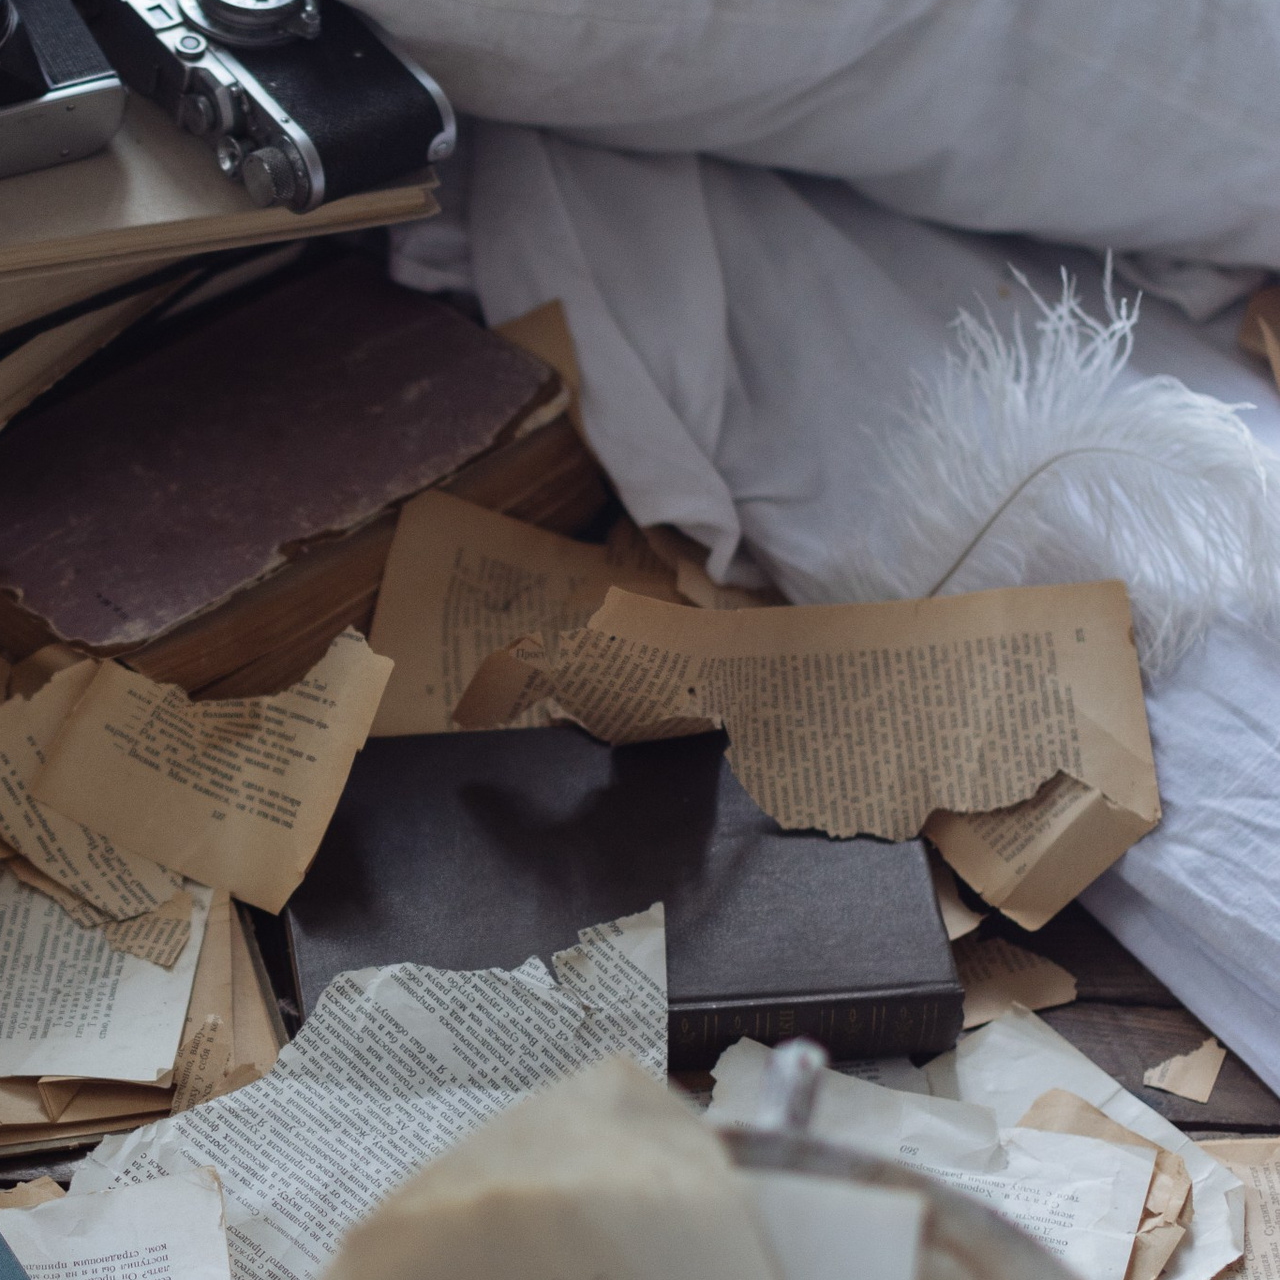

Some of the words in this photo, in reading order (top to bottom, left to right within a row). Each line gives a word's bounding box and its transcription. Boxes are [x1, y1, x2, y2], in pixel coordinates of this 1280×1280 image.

[398, 964, 424, 988] собой
[561, 958, 587, 983] своих
[343, 976, 365, 997] взял
[389, 972, 436, 1014] откровение.
[595, 973, 632, 1009] слушать.
[422, 985, 450, 1011] самим
[448, 1007, 466, 1026] над
[596, 991, 638, 1031] анекдотов
[630, 1007, 655, 1030] легче
[407, 1035, 427, 1054] был
[438, 1014, 490, 1064] заключалось
[465, 1024, 510, 1067] господства
[197, 1047, 211, 1071] себя
[274, 1057, 288, 1070] на
[425, 1051, 438, 1064] не
[286, 1067, 326, 1101] несмотря
[299, 1061, 334, 1095] научила.
[499, 1073, 521, 1093] этом
[508, 1065, 533, 1090] терял
[333, 1093, 350, 1109] вас
[456, 1081, 483, 1105] видел
[215, 1110, 263, 1151] романтики.
[348, 1107, 387, 1139] кой-чему
[189, 1136, 206, 1151] это
[386, 1137, 408, 1158] тоже
[898, 1143, 920, 1156] 560
[203, 1147, 229, 1169] менее
[259, 1148, 290, 1173] против
[892, 1157, 963, 1179] разговорами.
[238, 1175, 255, 1190] тем
[287, 1170, 338, 1212] возражений
[950, 1181, 993, 1197] Хорошо
[967, 1175, 1006, 1189] своими
[1009, 1181, 1041, 1195] толку
[270, 1196, 310, 1232] нравится,
[225, 1223, 266, 1258] Придется
[308, 1229, 321, 1242] не
[72, 1249, 139, 1267] страдающим
[320, 1240, 337, 1254] это
[140, 1263, 170, 1279] лать?
